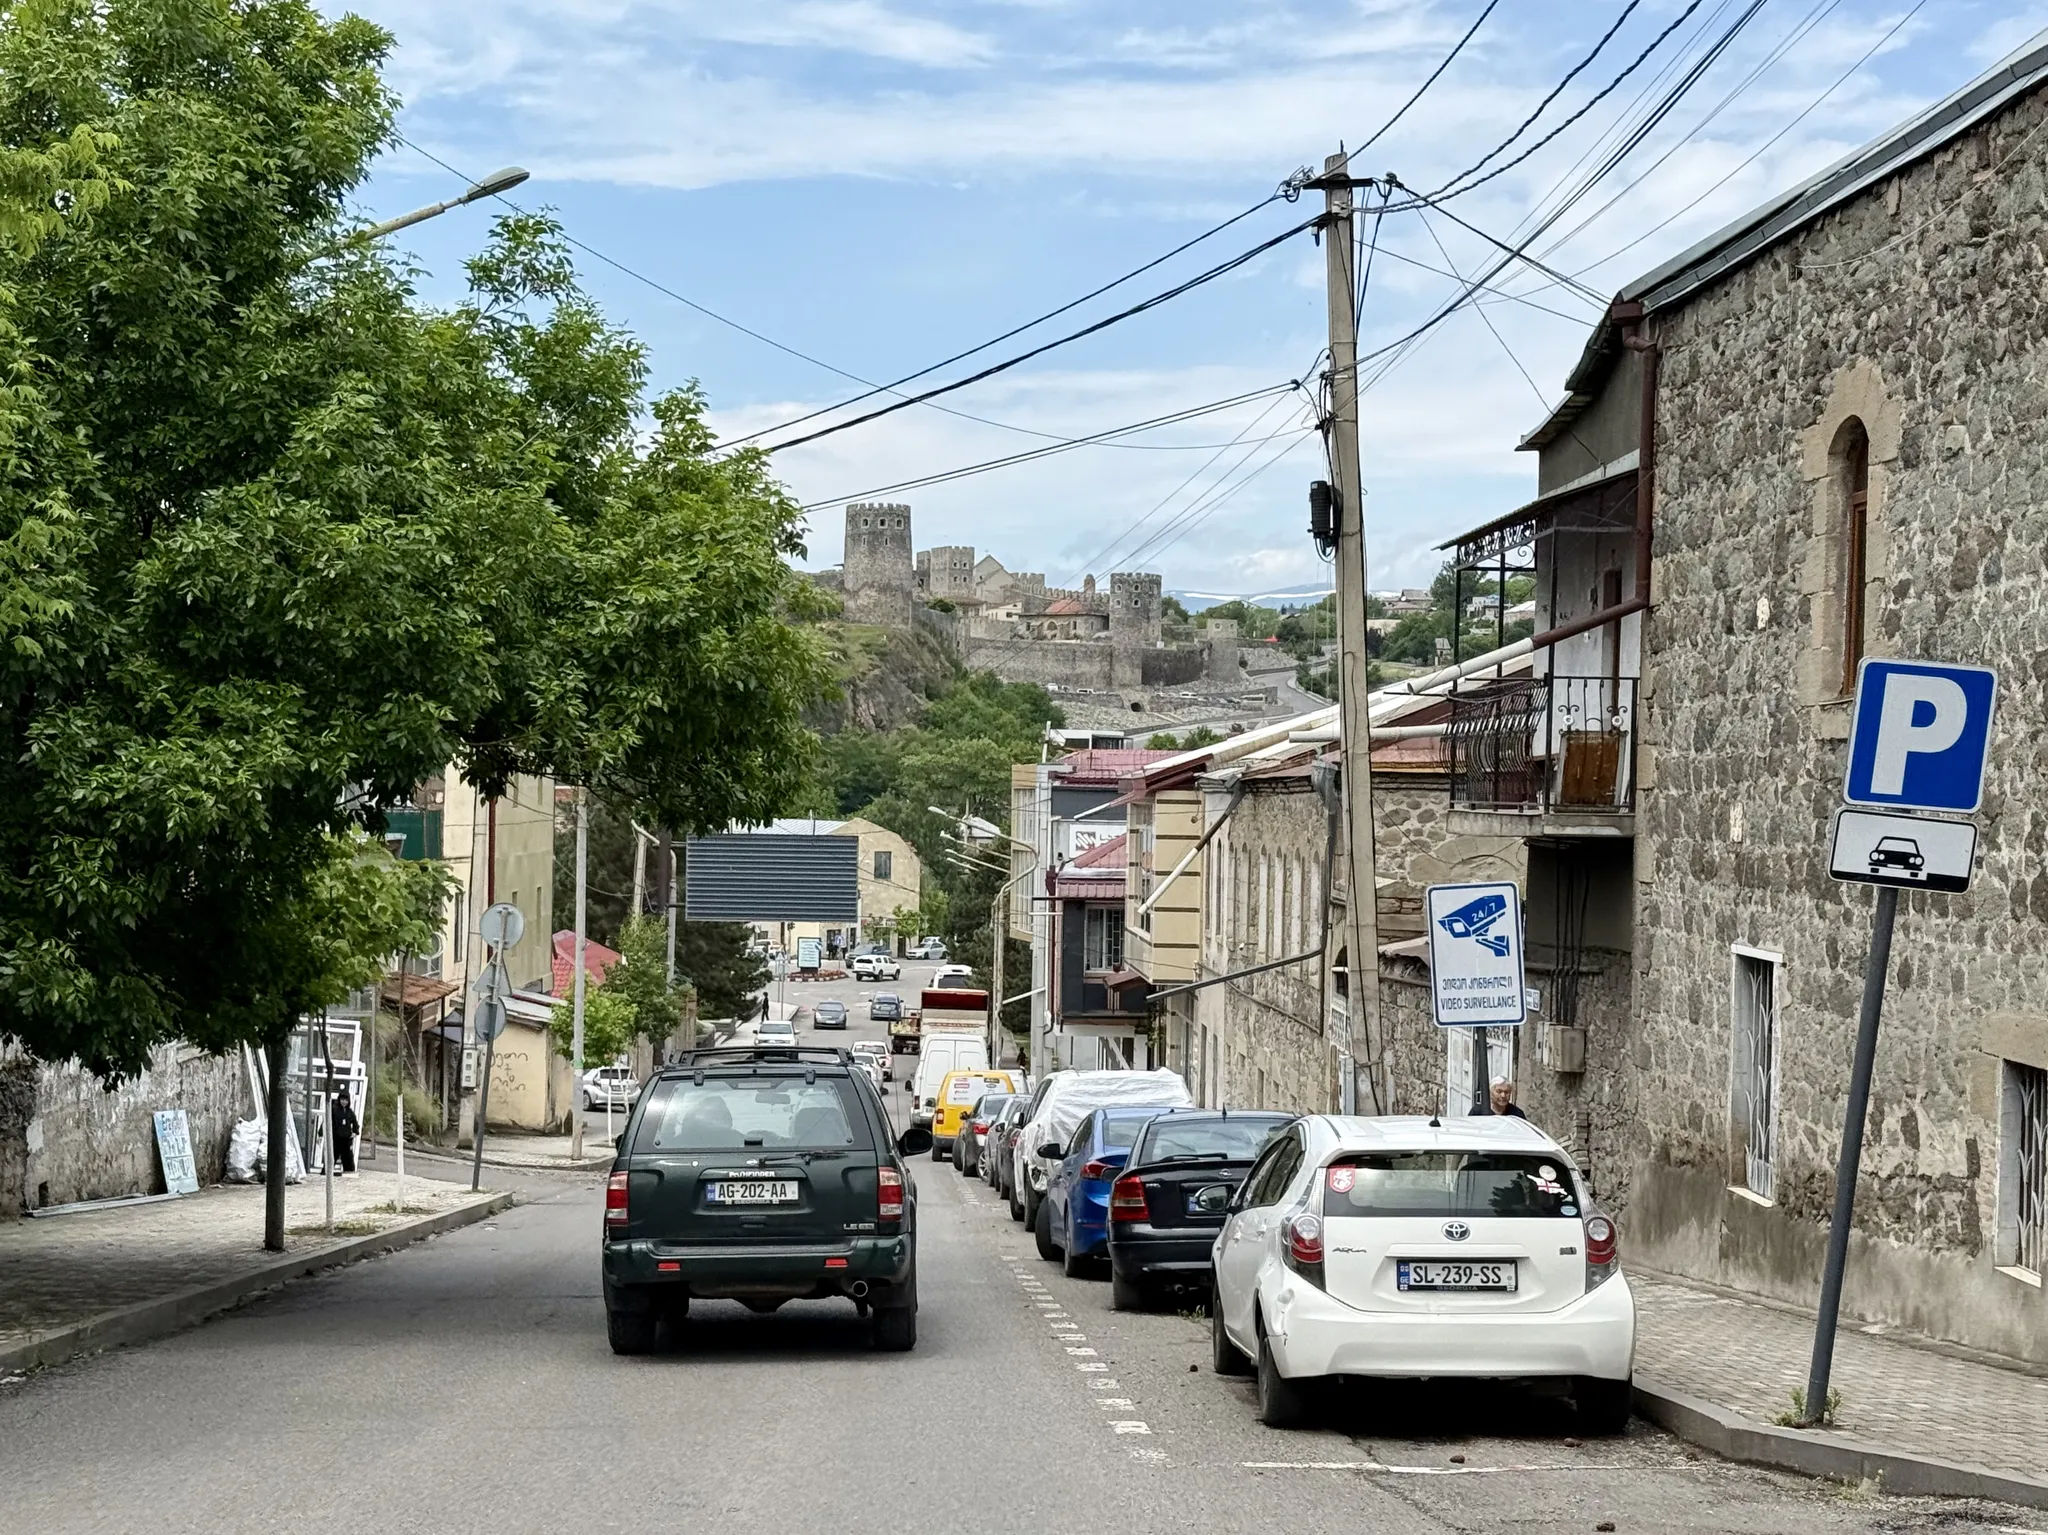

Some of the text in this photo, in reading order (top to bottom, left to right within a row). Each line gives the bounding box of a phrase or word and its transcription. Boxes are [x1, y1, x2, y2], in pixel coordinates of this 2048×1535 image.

[1870, 673, 1967, 795] P
[1471, 902, 1496, 922] 24/7
[1440, 997, 1462, 1010] VIDEO
[1463, 995, 1517, 1009] SURVEILLANCE
[718, 1183, 787, 1198] AG-202-AA
[1413, 1265, 1502, 1284] SL-239-SS
